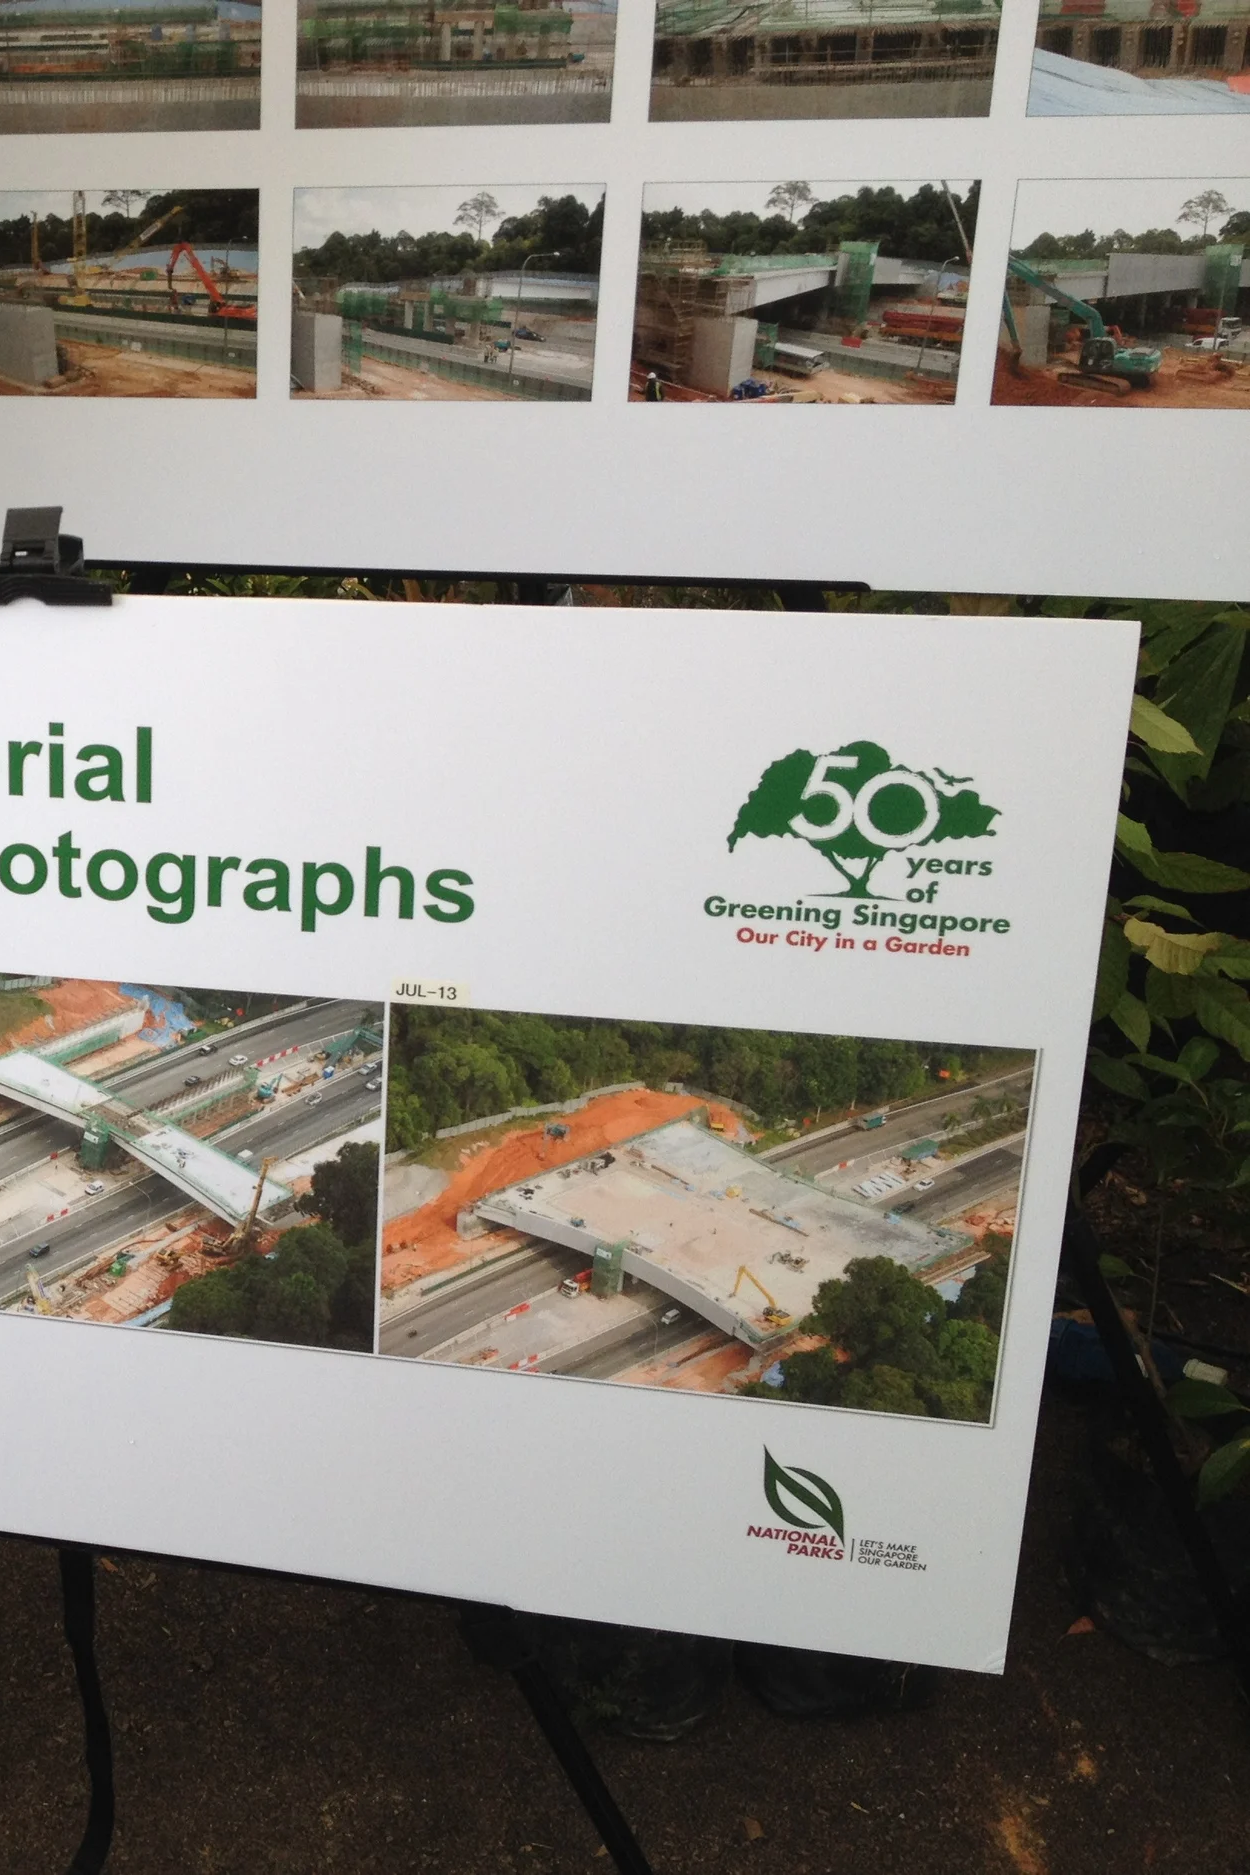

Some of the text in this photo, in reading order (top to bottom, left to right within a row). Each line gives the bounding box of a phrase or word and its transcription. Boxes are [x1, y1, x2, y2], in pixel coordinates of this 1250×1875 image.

[788, 755, 940, 849] 50
[906, 857, 993, 878] years
[906, 881, 939, 904] of
[703, 895, 1011, 937] Greening Singapore
[736, 927, 970, 957] Our City in a Garden
[396, 983, 457, 1001] JUL-13
[747, 1525, 838, 1547] NATIONAL
[859, 1539, 917, 1553] LET'S MAKE
[786, 1543, 845, 1561] PARKS
[858, 1547, 919, 1562] SINGAPORE
[857, 1556, 927, 1572] OUR GARDEN
